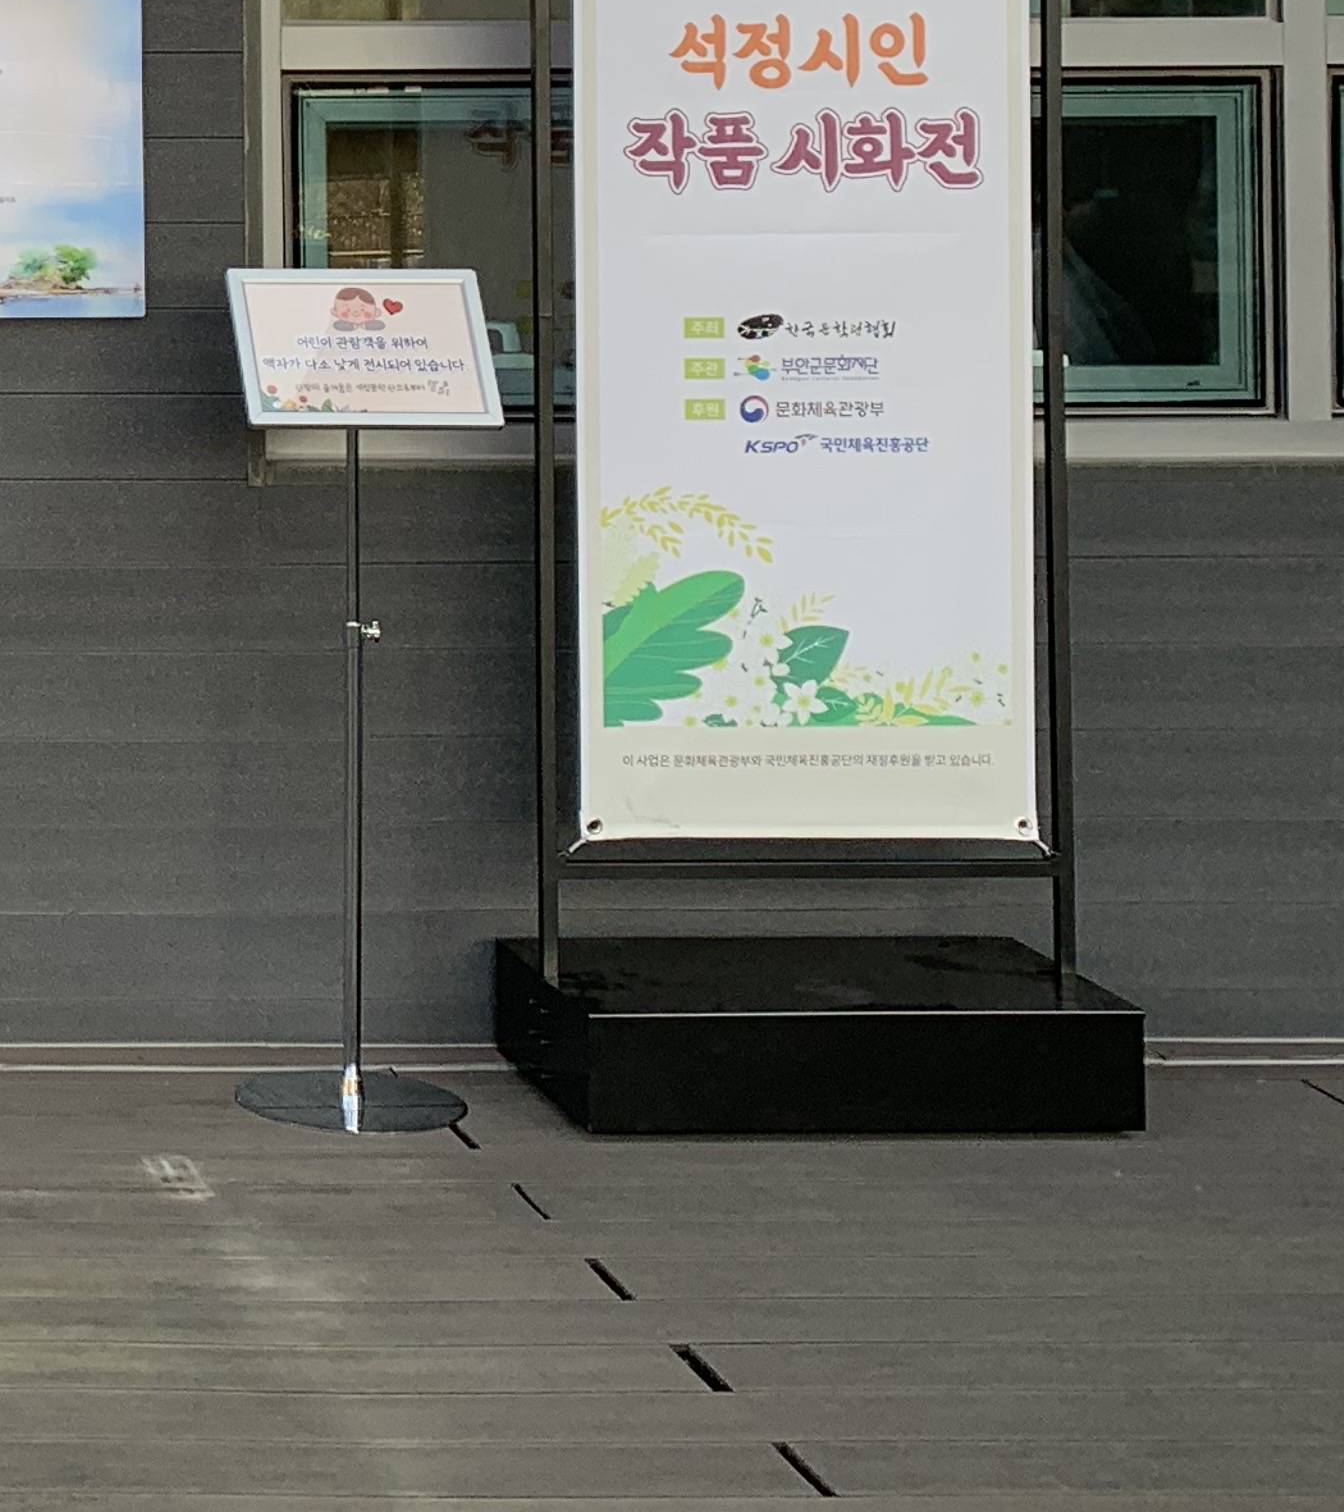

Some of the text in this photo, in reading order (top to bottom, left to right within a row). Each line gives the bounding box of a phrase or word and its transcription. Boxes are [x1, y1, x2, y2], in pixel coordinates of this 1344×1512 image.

[668, 11, 930, 90] 석정시인
[625, 110, 765, 194] 작품
[769, 107, 982, 193] 시화전
[297, 335, 428, 350] 어린이 관람객을 위하여
[262, 358, 464, 371] 액자가 다소 낮게 전시되어 있습니다
[691, 362, 719, 376] 주관
[781, 354, 880, 376] 부안군문화재단
[691, 403, 720, 416] 후원
[776, 401, 884, 418] 문화체육관광부
[744, 437, 929, 454] KSPO 국민체육진흥공단
[622, 754, 634, 767] 이
[637, 754, 670, 767] 사업은
